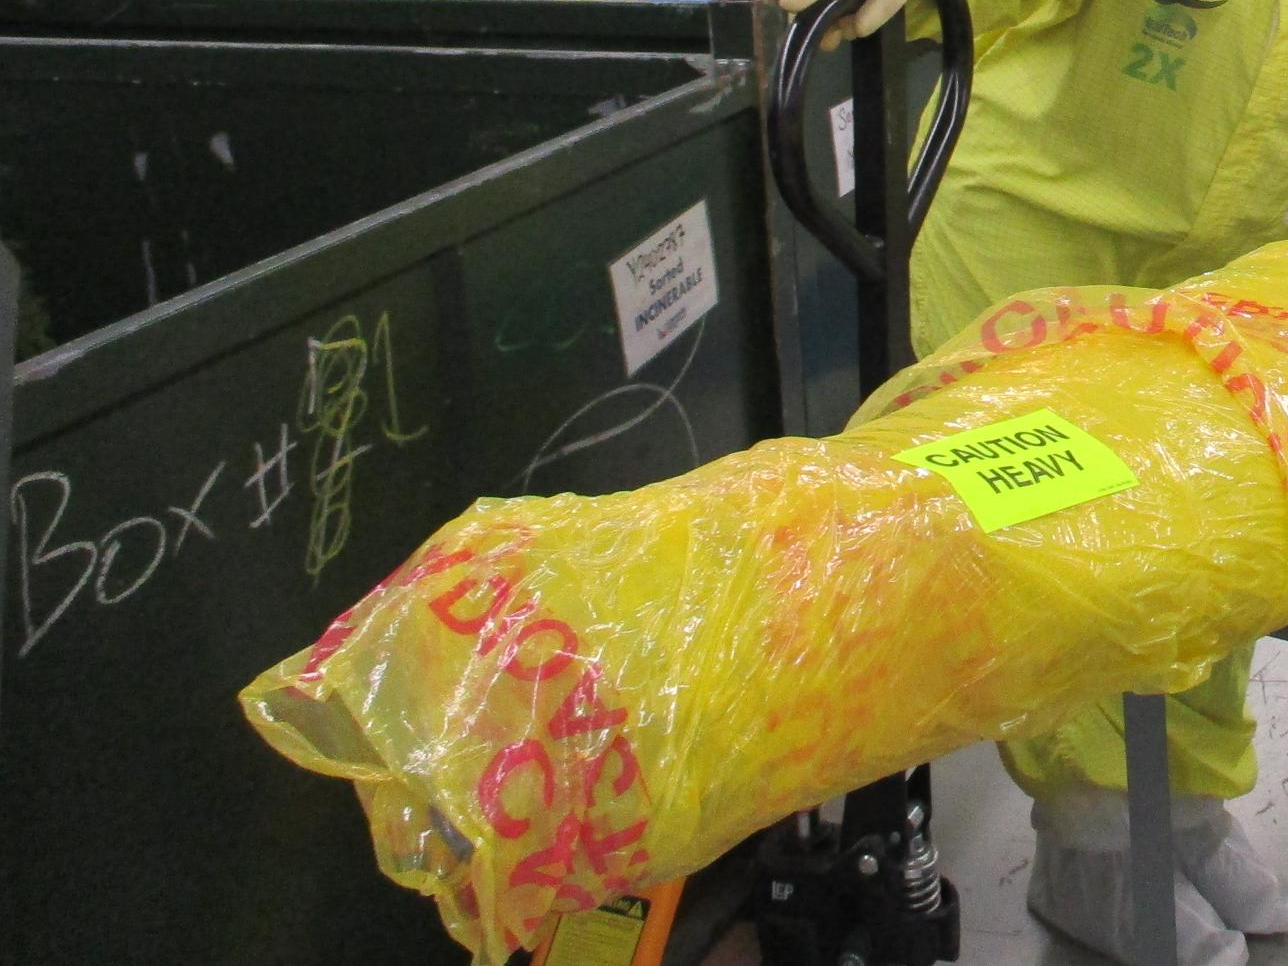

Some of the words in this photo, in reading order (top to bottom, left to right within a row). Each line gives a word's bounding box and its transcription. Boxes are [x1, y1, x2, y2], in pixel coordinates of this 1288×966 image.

[1122, 41, 1186, 92] 2X
[634, 266, 704, 332] INCINERABLE
[924, 424, 1072, 468] CAUTION
[975, 449, 1085, 494] HEAVY
[11, 460, 227, 657] Box
